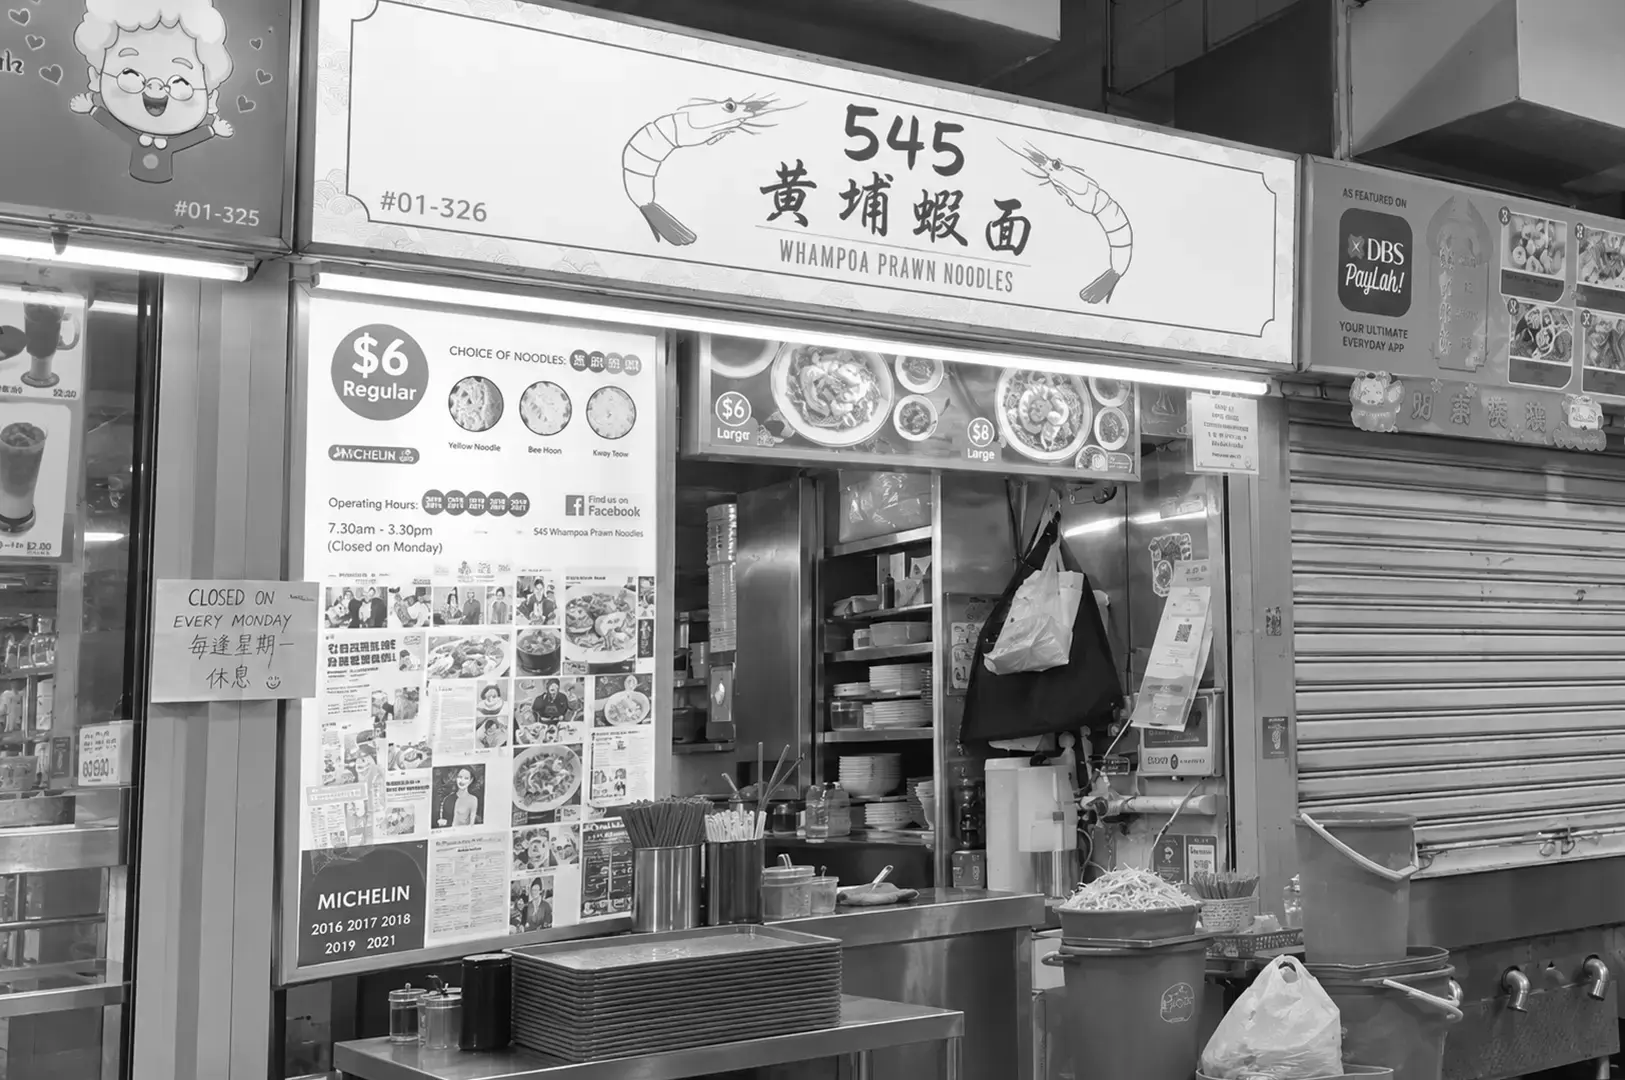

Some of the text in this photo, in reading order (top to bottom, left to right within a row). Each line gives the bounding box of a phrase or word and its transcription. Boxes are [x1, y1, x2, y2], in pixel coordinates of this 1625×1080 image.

[844, 103, 965, 177] 545
[380, 190, 488, 223] #01-326
[1342, 187, 1408, 209] AS FEATURED ON
[174, 199, 260, 227] #01-325
[1367, 238, 1405, 266] DBS
[779, 238, 1013, 293] WHAMPOA PRAWN NOODLES
[1345, 262, 1405, 296] PayLah!
[1339, 320, 1409, 340] YOUR ULTIMATE
[1342, 335, 1405, 353] EVERYDAY APP
[351, 332, 409, 379] $6
[449, 345, 493, 360] CHOICE
[495, 350, 511, 360] OF
[514, 352, 567, 366] NOODLES:
[343, 379, 417, 403] Regular
[722, 396, 745, 420] $6
[972, 422, 990, 443] $8
[448, 442, 501, 452] Yellow Noodle
[528, 446, 562, 455] Bee Hoon
[967, 447, 996, 462] Large
[328, 497, 382, 511] Operating
[385, 499, 418, 510] Hours:
[589, 495, 606, 504] Find
[589, 505, 641, 517] Facebook
[328, 522, 375, 534] 7.30am
[388, 524, 433, 538] 3.30pm
[549, 527, 589, 538] Whampoa
[590, 528, 614, 537] Prawn
[615, 529, 644, 538] Noodles
[327, 540, 443, 555] (Closed on Monday)
[188, 588, 276, 607] CLOSED ON
[173, 614, 293, 634] EVERY MONDAY
[205, 664, 251, 690] 休息
[317, 885, 411, 911] MICHELIN
[311, 913, 412, 936] 2016 2017 2018
[325, 935, 396, 954] 2019 2021
